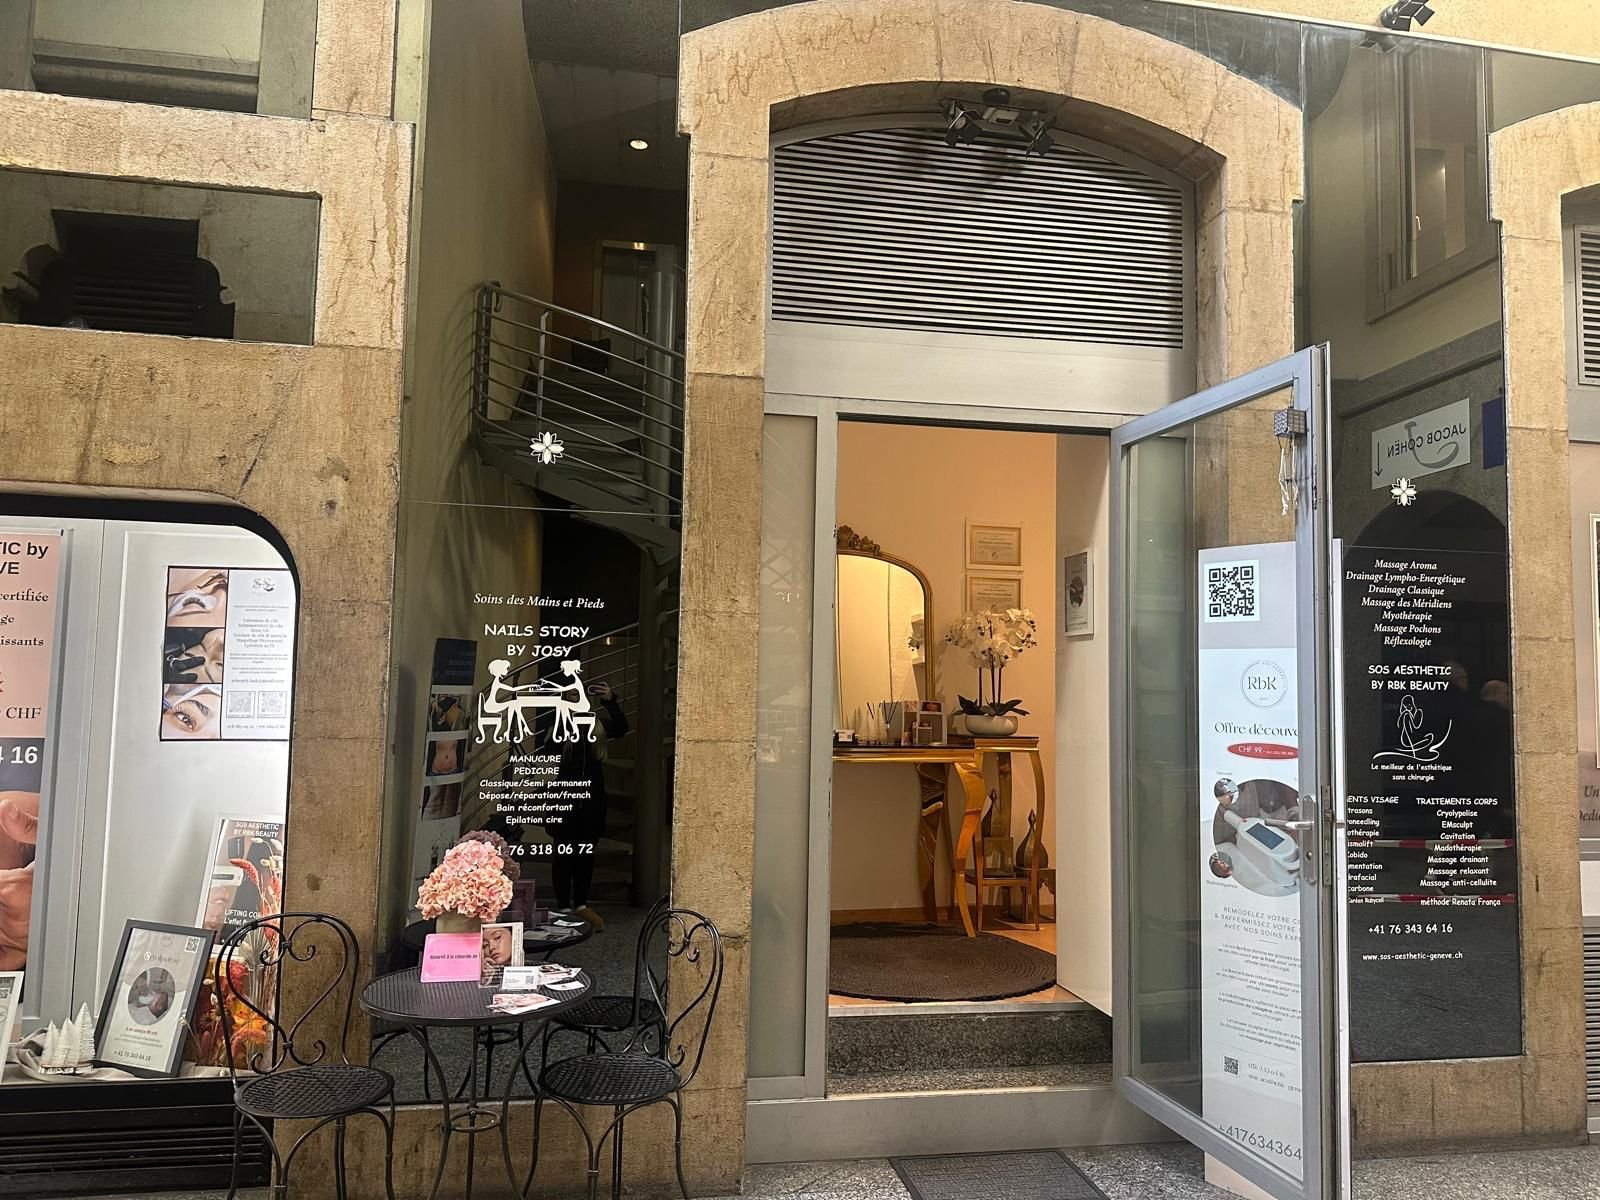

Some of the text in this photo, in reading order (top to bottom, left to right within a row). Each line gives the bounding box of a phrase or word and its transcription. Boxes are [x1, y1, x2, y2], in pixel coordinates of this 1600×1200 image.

[27, 542, 48, 559] by
[1374, 559, 1437, 571] Massage Aroma
[1345, 571, 1466, 586] Drainage Lympho-Energétique
[1368, 585, 1445, 597] Drainage Classique
[473, 592, 605, 609] Soins des Mains et Pieds
[1361, 597, 1452, 609] Massage des Méridiens
[1382, 610, 1433, 622] Myothérapie
[484, 623, 590, 638] NAILS STORY
[1373, 623, 1442, 635] Massage Pochons
[1384, 636, 1432, 648] Réflexologie
[507, 644, 572, 658] BY JOSY
[1368, 665, 1452, 676] SOS AESTHETIC
[1371, 680, 1450, 691] BY RBK BEAUTY
[6, 707, 41, 719] CHF
[1214, 721, 1247, 735] Offre
[11, 746, 38, 764] 16
[509, 754, 562, 764] MANUCURE
[513, 766, 560, 775] PEDICURE
[479, 778, 592, 789] Classique/Semi permanent
[479, 790, 591, 801] Dépose/réparation/french
[1370, 796, 1400, 804] VISAGE
[1416, 797, 1498, 806] TRAITEMENTS CORPS
[496, 803, 573, 812] Bain réconfortant
[505, 815, 563, 825] Epilation cire
[1441, 820, 1474, 830] EMsculpt
[255, 830, 279, 838] BEAUTY
[1440, 832, 1476, 840] Cavitation
[509, 845, 525, 856] 76
[530, 844, 552, 855] 318
[557, 844, 573, 855] 06
[578, 843, 594, 855] 72
[1427, 856, 1458, 865] Massage
[1427, 867, 1489, 876] Massage relaxant
[1420, 878, 1497, 888] Massage anti-cellulite
[1420, 897, 1501, 907] méthode Renata França
[1368, 923, 1453, 935] +41 76 343 64 16
[1362, 951, 1464, 961] www.sos-aesthetic-geneve.ch
